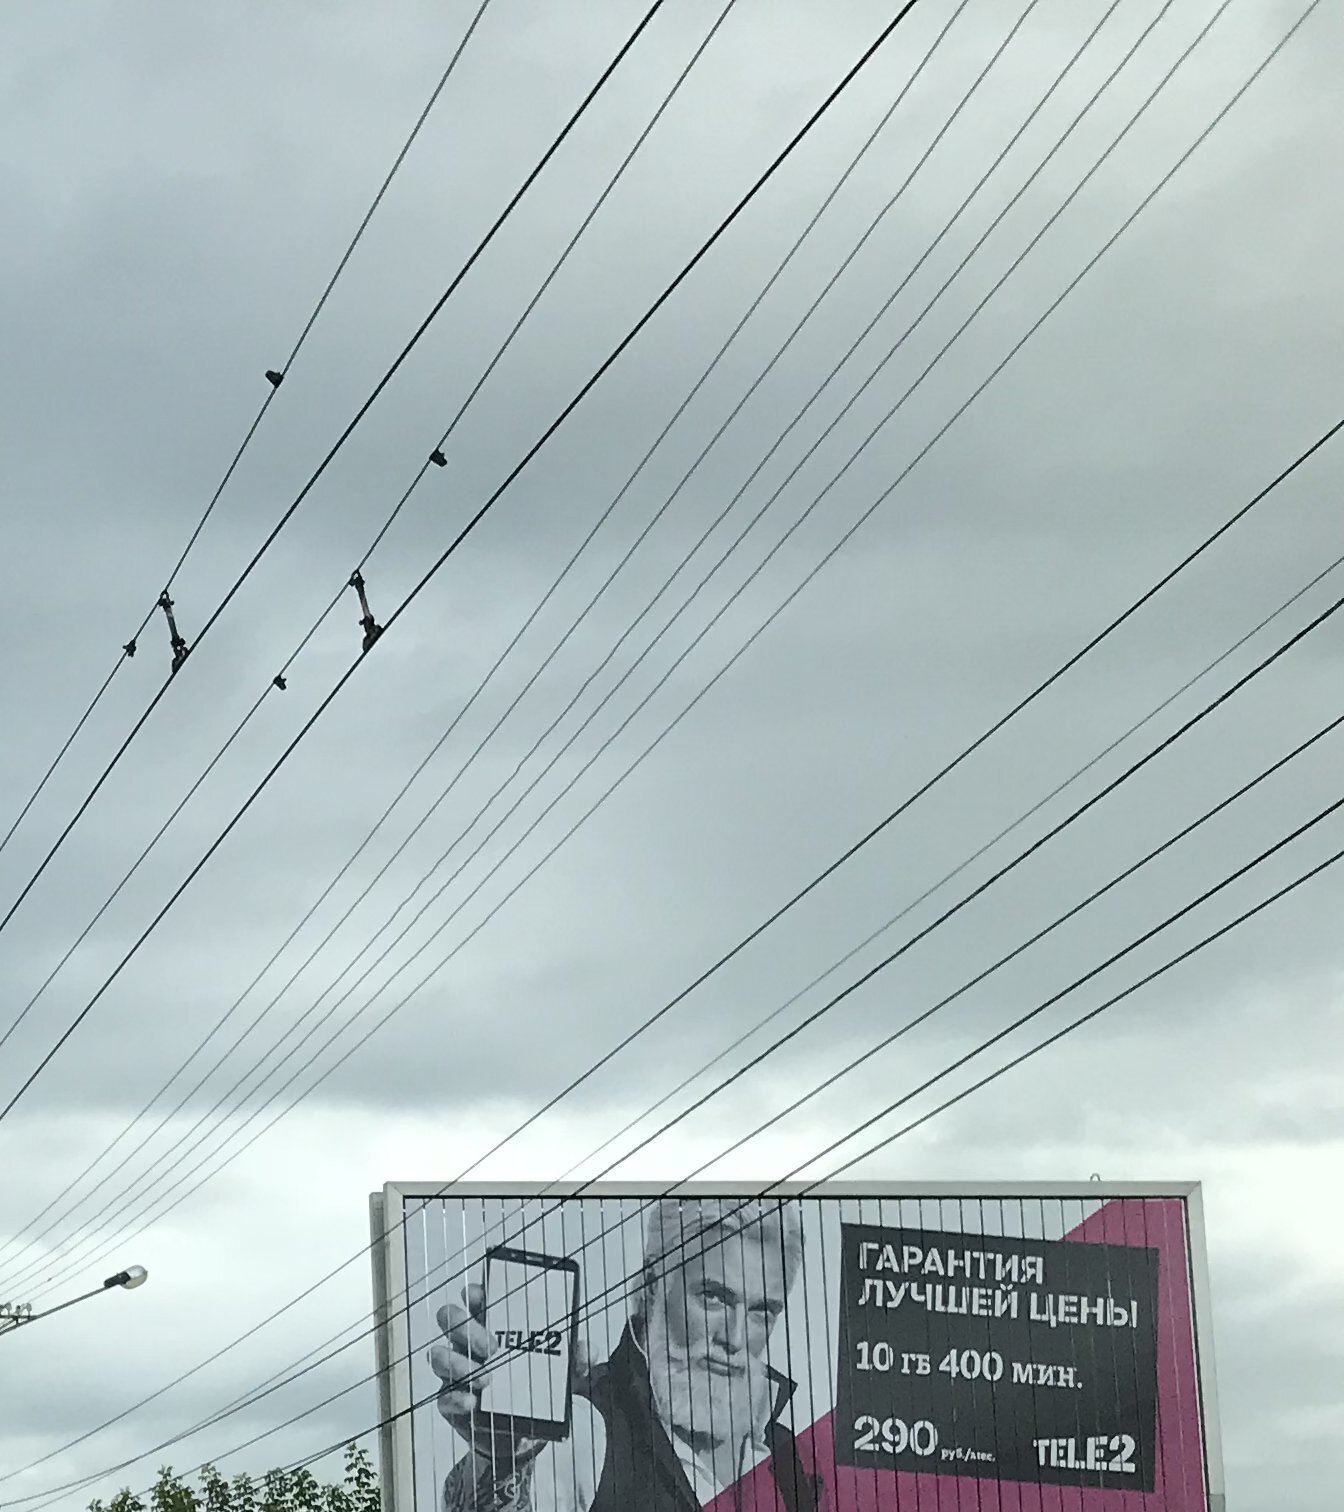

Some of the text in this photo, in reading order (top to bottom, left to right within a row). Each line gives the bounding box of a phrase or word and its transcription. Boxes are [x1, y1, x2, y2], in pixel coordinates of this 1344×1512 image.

[858, 1241, 1044, 1285] ГАРАНТИЯ
[857, 1277, 1139, 1329] ЛУЧШЕЙ ЦЕНЫ
[494, 1329, 562, 1357] TELE2
[855, 1340, 894, 1372] 10
[938, 1348, 1004, 1382] 400
[853, 1414, 939, 1457] 290
[1032, 1433, 1137, 1474] TELE2
